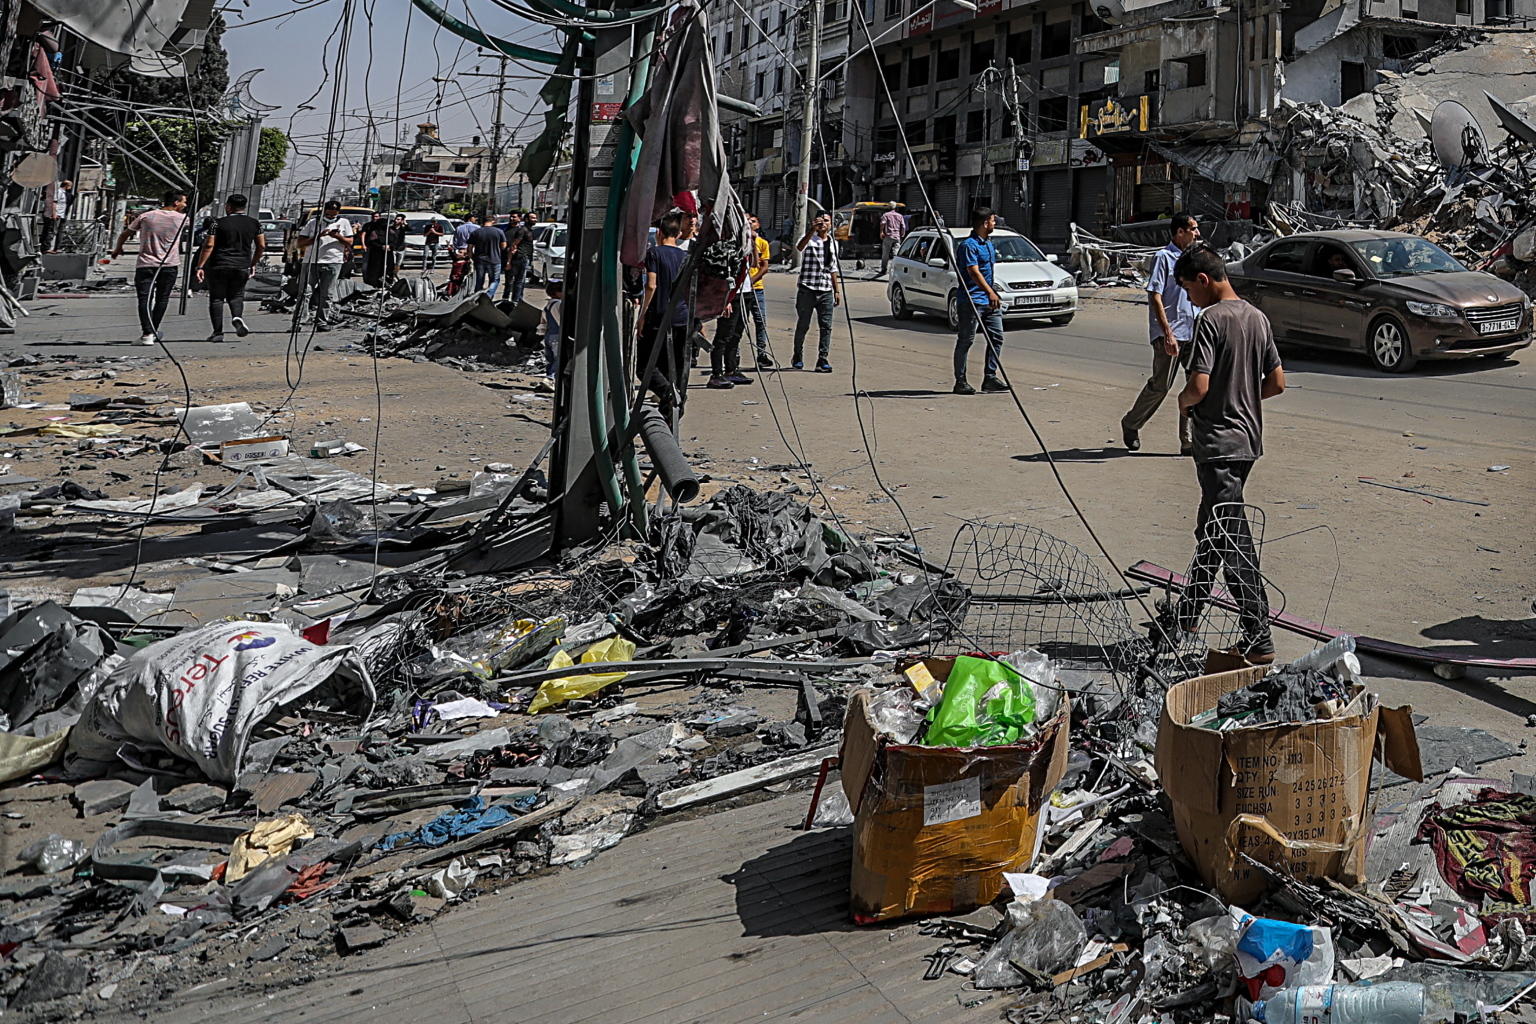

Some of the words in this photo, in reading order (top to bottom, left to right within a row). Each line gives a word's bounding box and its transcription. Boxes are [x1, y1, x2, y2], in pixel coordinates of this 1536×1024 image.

[265, 646, 313, 674] WHITE
[1236, 756, 1259, 769] ITEM
[1236, 787, 1254, 799] SIZE
[1292, 782, 1303, 793] 24
[1305, 780, 1315, 791] 25
[1317, 778, 1327, 790] 26
[1329, 776, 1338, 788] 27
[1235, 802, 1273, 814] FUCHSIA
[1295, 798, 1301, 809] 3
[1307, 797, 1313, 807] 3
[1319, 794, 1325, 806] 3
[1331, 792, 1336, 803] 3
[1294, 815, 1300, 826] 3
[1306, 813, 1312, 824] 3
[1319, 811, 1325, 822] 3
[1330, 809, 1336, 820] 3
[1341, 806, 1347, 817] 3
[1311, 827, 1325, 839] CM
